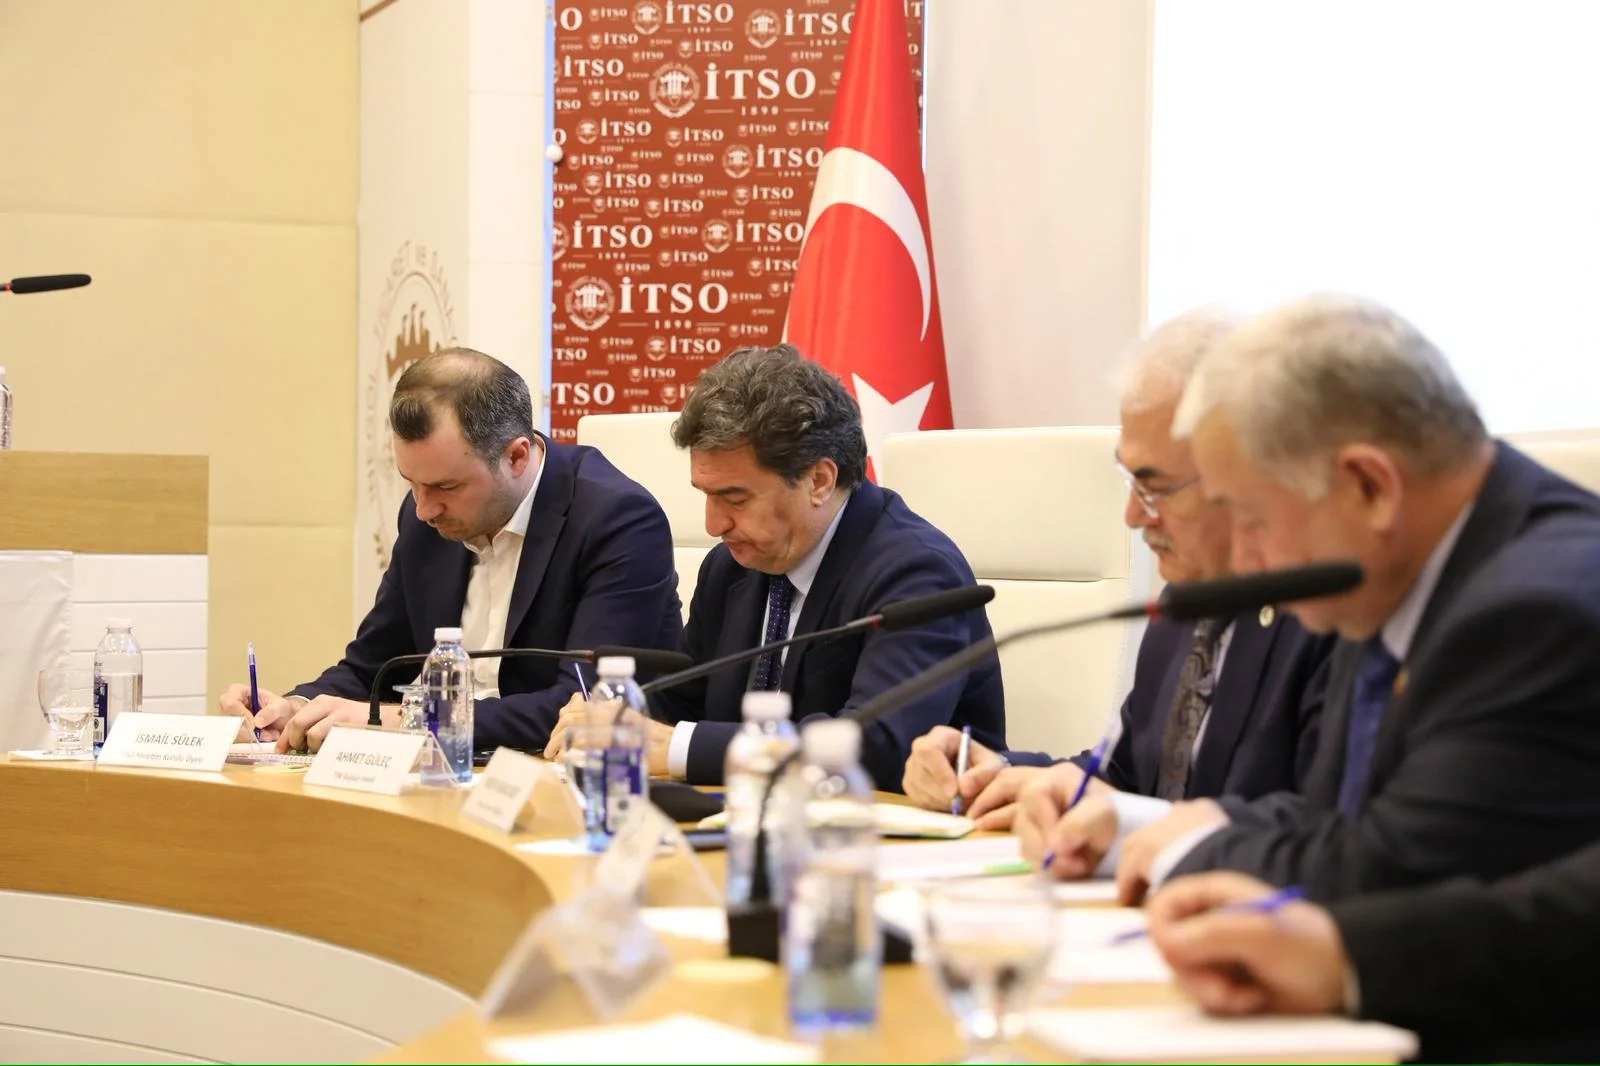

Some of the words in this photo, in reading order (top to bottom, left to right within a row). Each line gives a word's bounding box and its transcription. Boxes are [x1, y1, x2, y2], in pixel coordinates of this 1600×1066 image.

[665, 0, 734, 24] İTSO
[695, 38, 733, 52] İTSO
[564, 55, 624, 77] İTSO
[704, 62, 816, 100] İTSO
[741, 106, 779, 116] 1890
[600, 117, 651, 136] İTSO
[684, 127, 724, 142] İTSO
[756, 144, 824, 168] İTSO
[605, 171, 652, 188] İTSO
[752, 184, 794, 200] İTSO
[664, 197, 704, 212] İTSO
[572, 220, 653, 248] İTSO
[736, 218, 804, 242] İTSO
[619, 276, 728, 314] İTSO
[654, 320, 692, 329] 1890
[670, 336, 721, 354] İTSO
[135, 731, 169, 745] İSMAİL
[171, 733, 205, 747] SÜLEK
